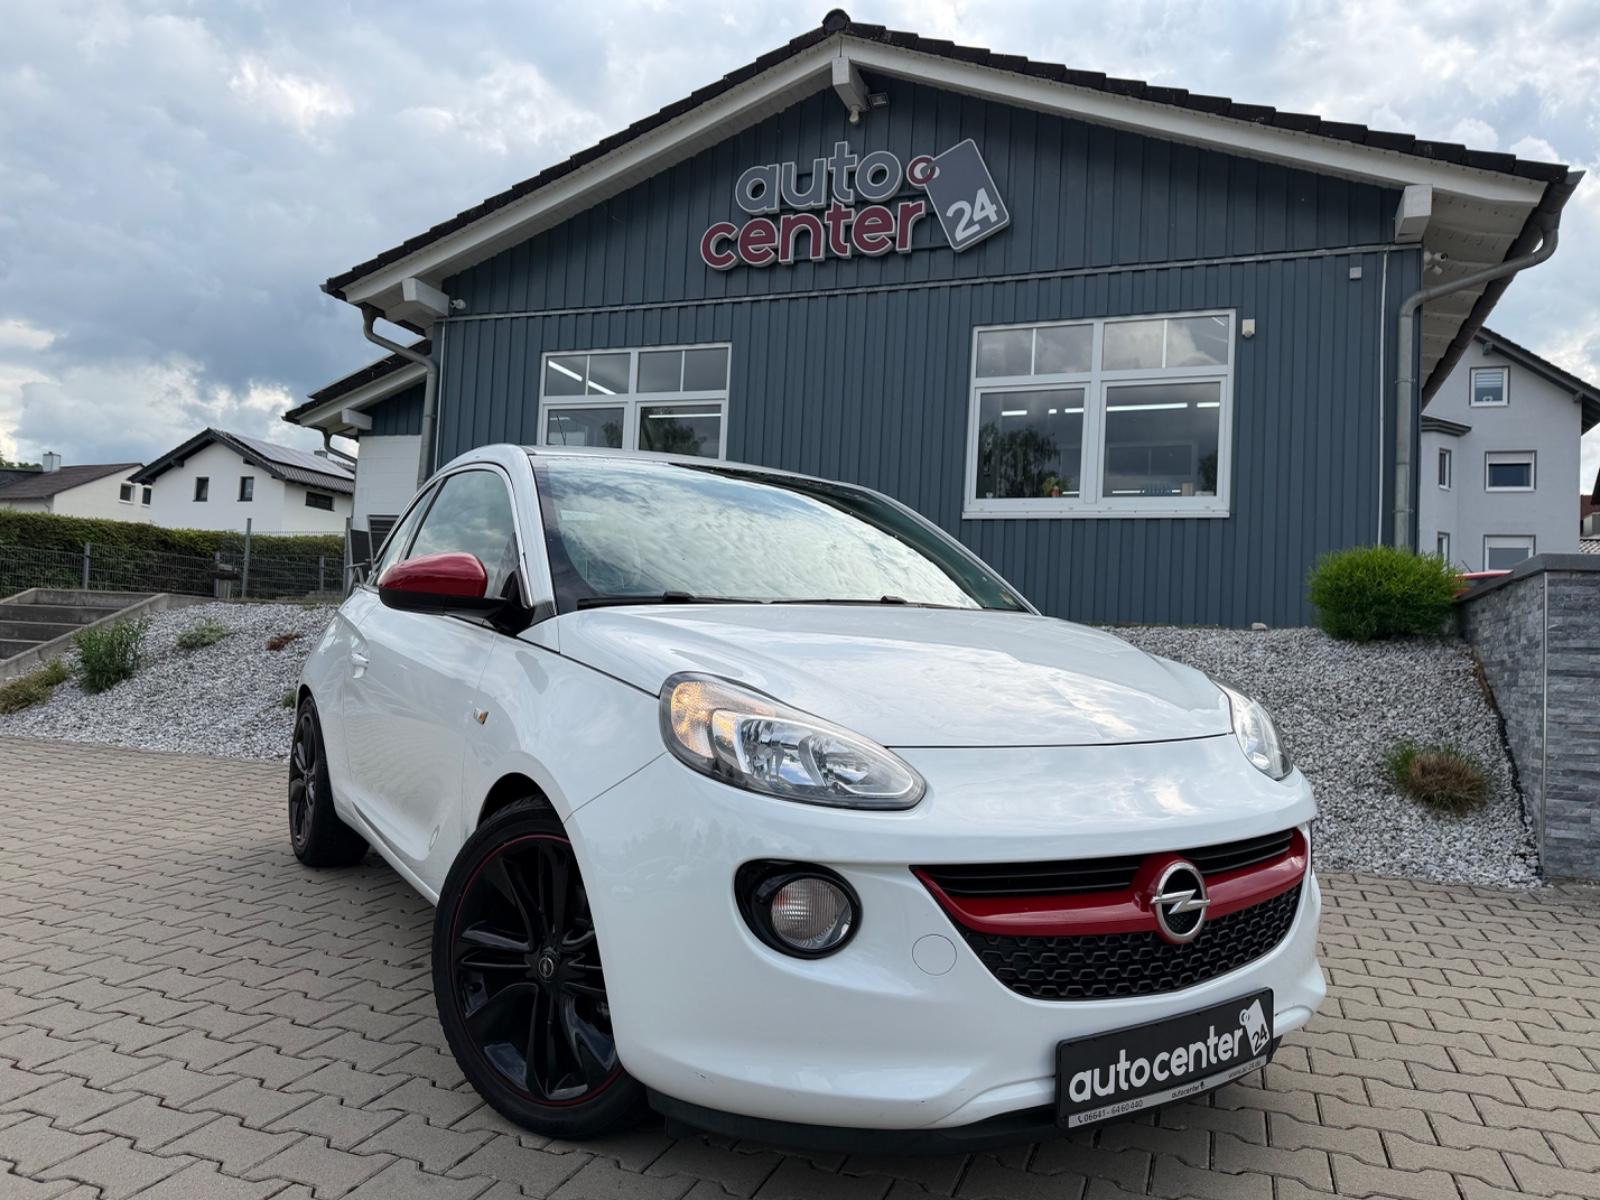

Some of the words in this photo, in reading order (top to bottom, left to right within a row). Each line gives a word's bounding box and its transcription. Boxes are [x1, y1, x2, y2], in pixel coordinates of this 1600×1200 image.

[735, 141, 902, 215] auto
[700, 200, 926, 271] center
[946, 188, 999, 242] 24
[1069, 1026, 1243, 1103] autocenter
[1252, 1023, 1267, 1052] 24
